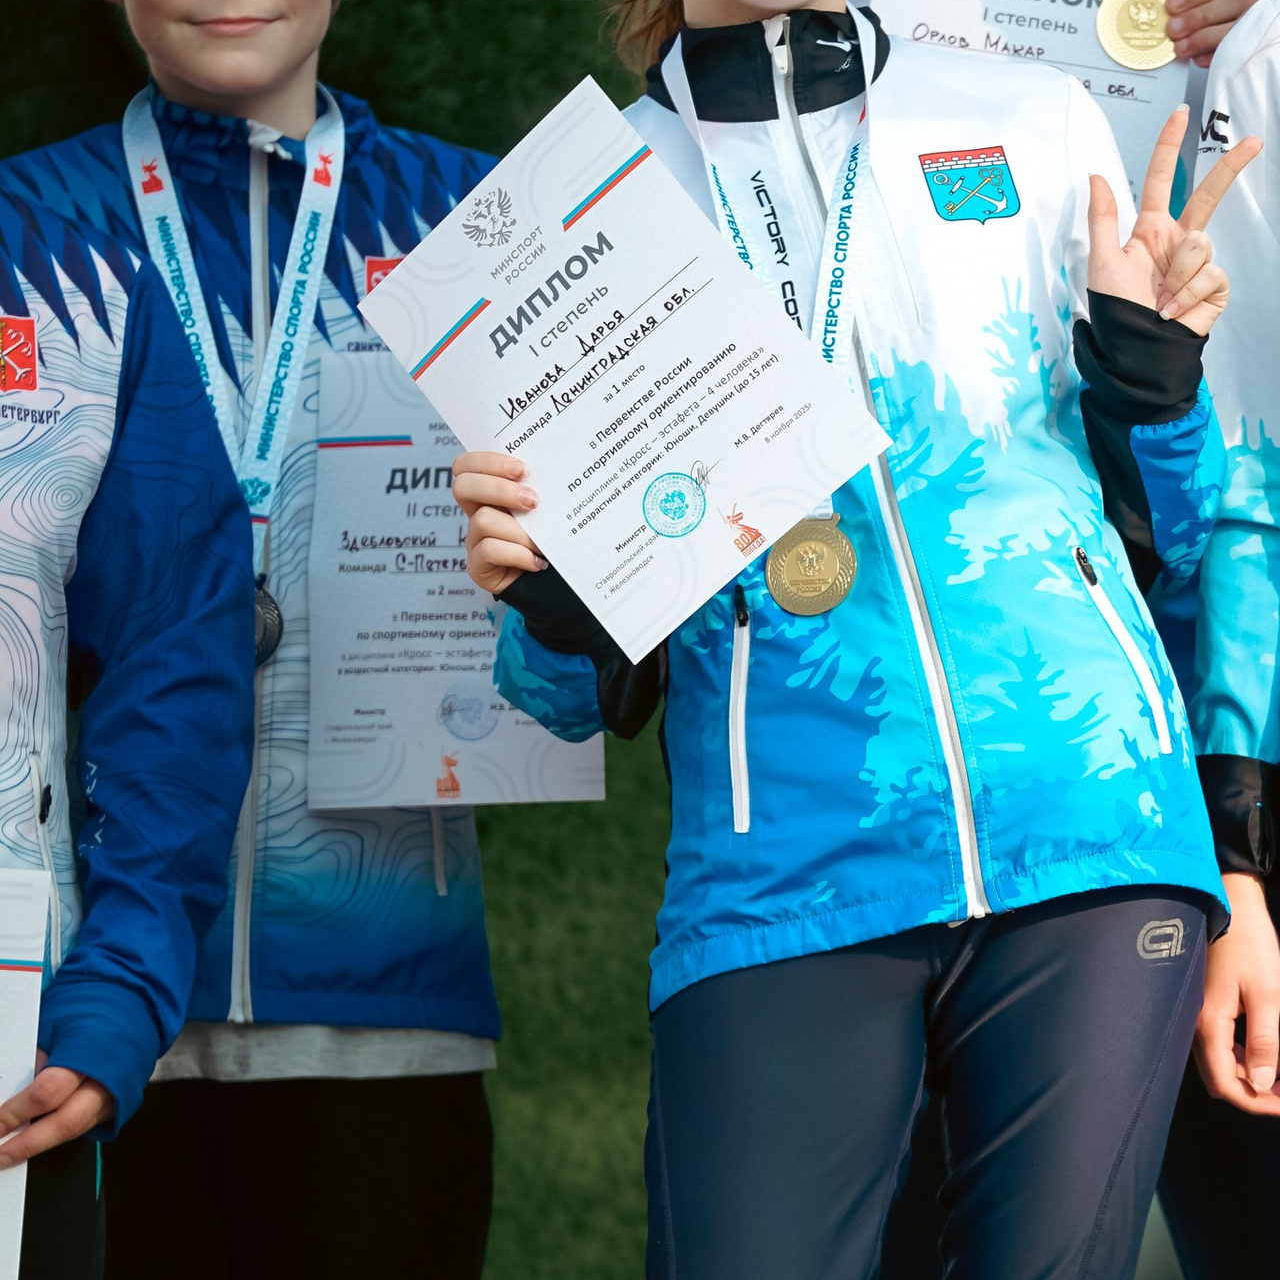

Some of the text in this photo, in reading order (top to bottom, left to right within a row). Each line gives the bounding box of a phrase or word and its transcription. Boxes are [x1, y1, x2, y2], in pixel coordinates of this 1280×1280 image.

[994, 11, 1078, 35] степень
[711, 163, 753, 270] МИНИСТЕРСТВ
[156, 215, 196, 329] МИНИСТЕРСТВО
[489, 225, 544, 281] МИНСПОРТ
[503, 242, 548, 286] РОССИИ
[750, 170, 803, 332] VICTORY CO
[822, 142, 861, 364] ИСТЕРСТВО СПОРТА РОССИИ
[488, 230, 615, 360] ДИПЛОМ
[539, 285, 609, 349] степень
[256, 210, 321, 461] МИНИСТЕРСТВО СПОРТА РОССИИ
[594, 356, 693, 443] Первенстве России
[602, 364, 646, 404] за 1 место
[1, 404, 60, 424] ЕТЕРБУРГ
[504, 411, 554, 455] Команда
[567, 342, 737, 493] по спортивному ориентированию
[386, 467, 453, 494] ДИП
[339, 563, 387, 573] Команда
[372, 630, 445, 641] спортивному
[401, 611, 468, 622] Первенстве
